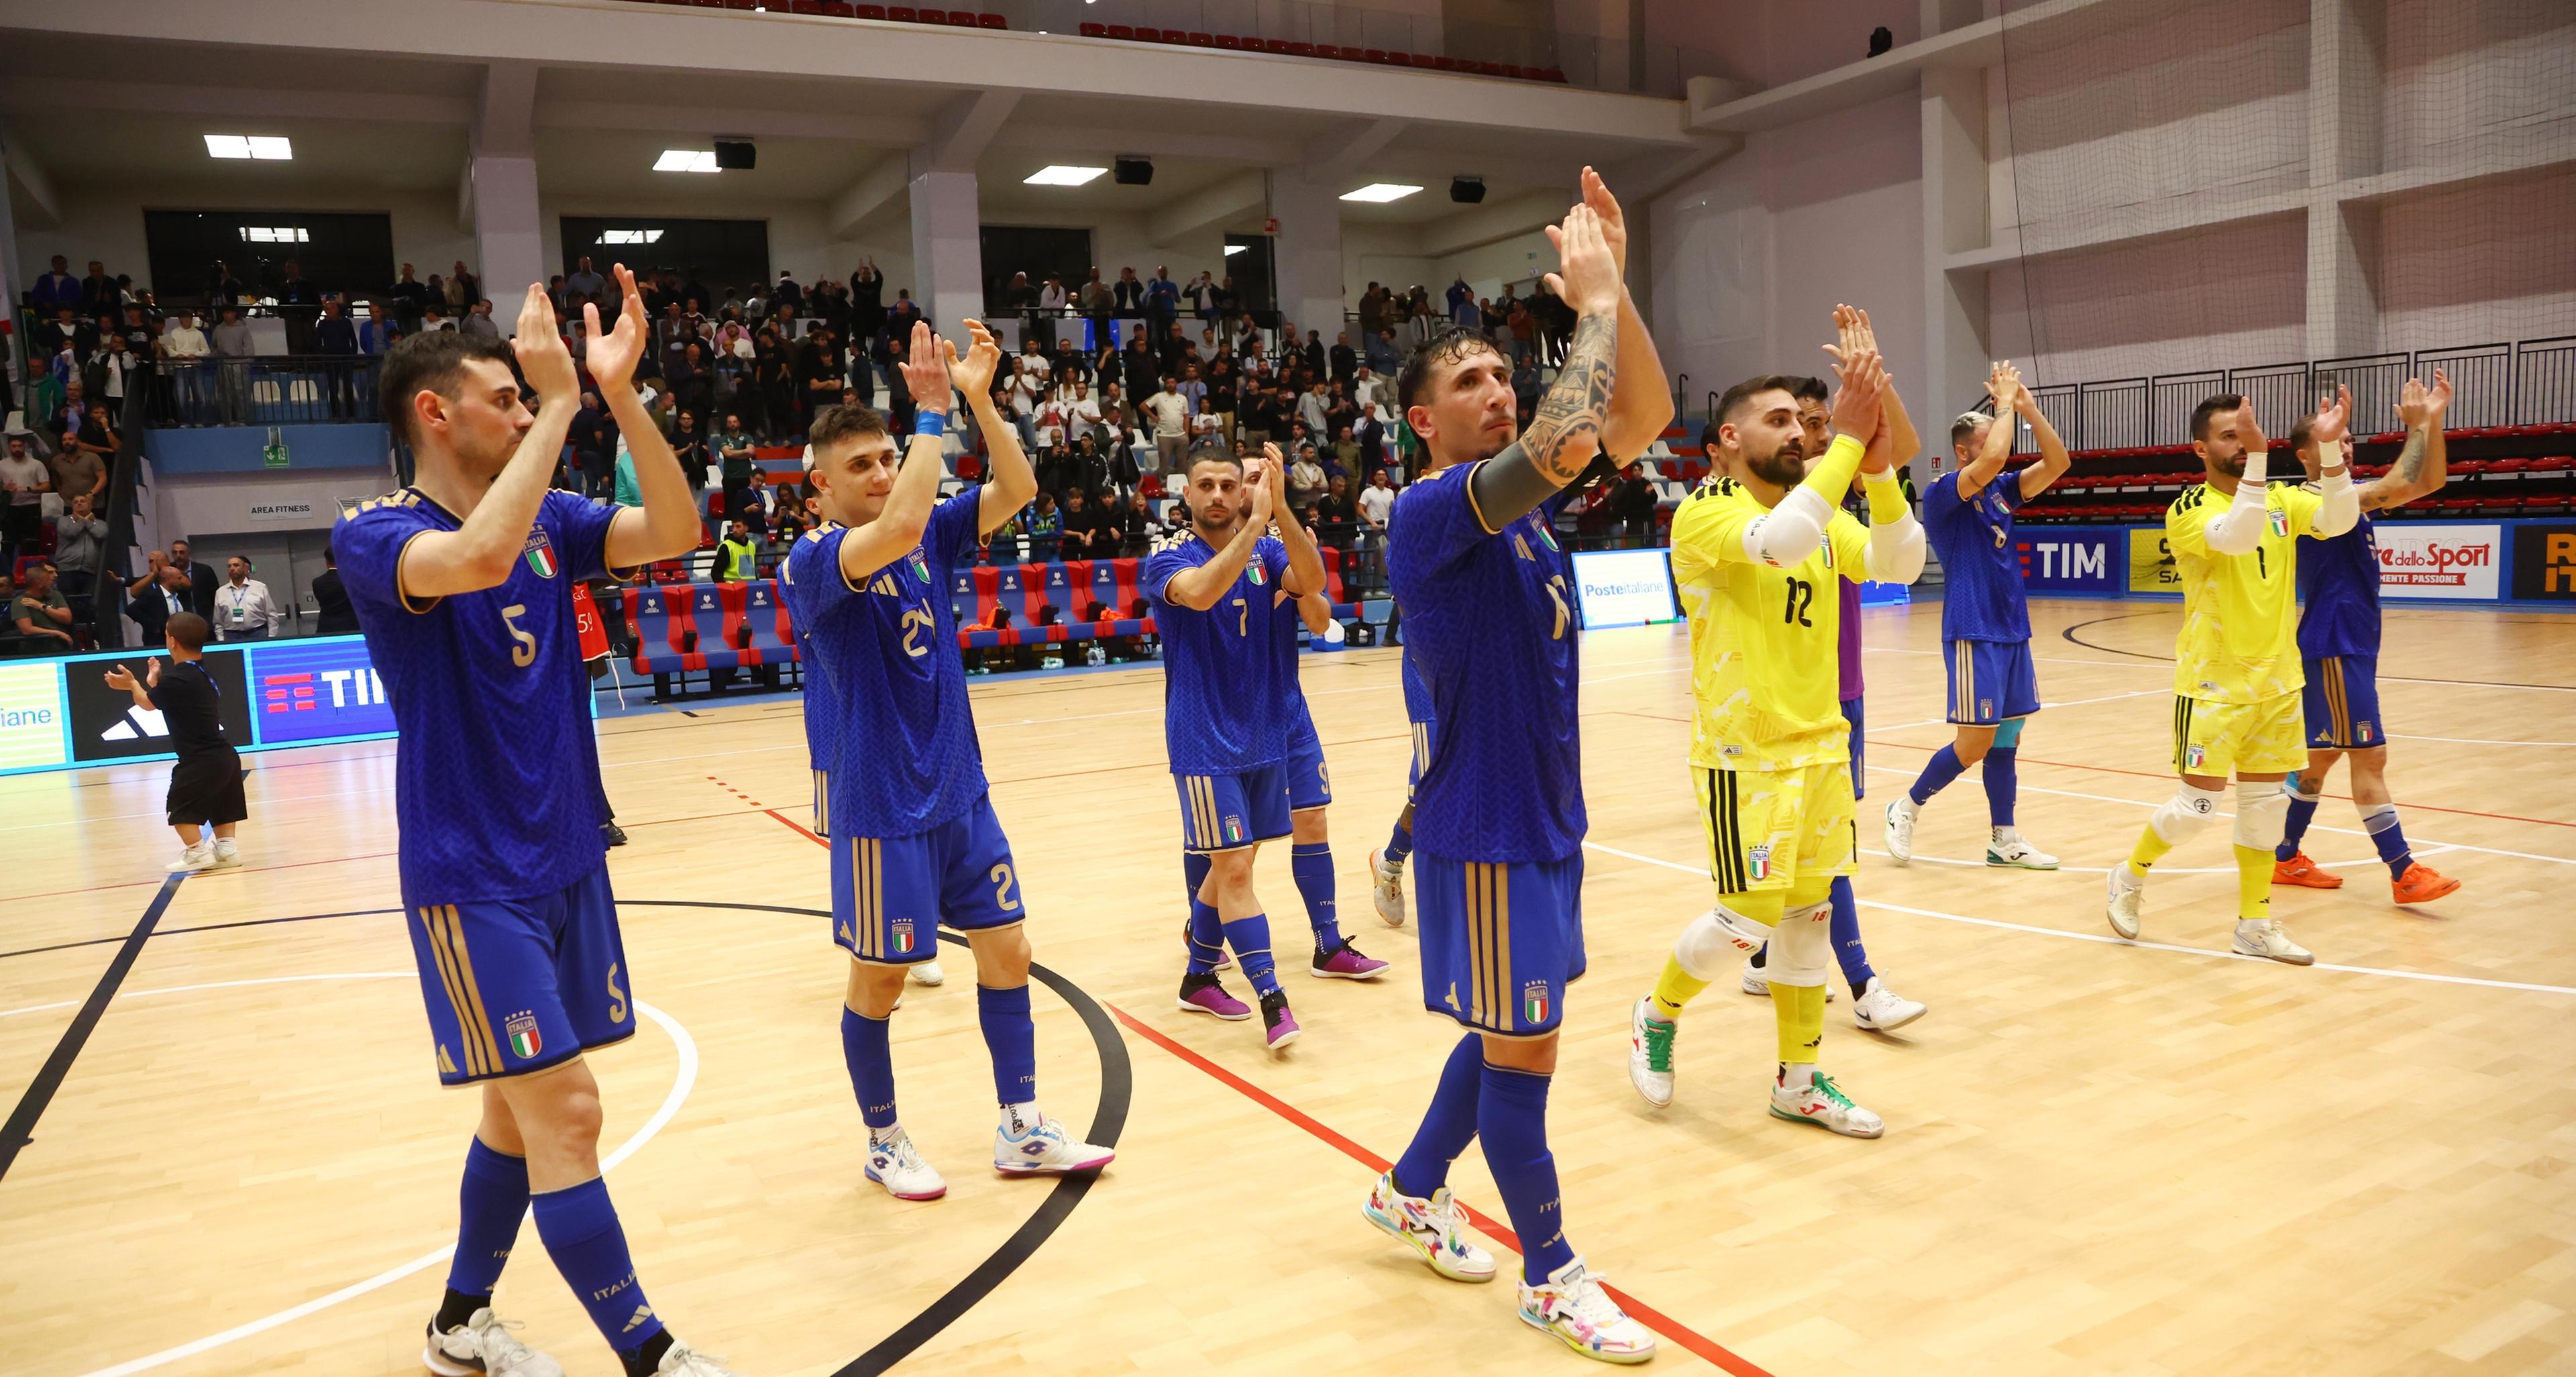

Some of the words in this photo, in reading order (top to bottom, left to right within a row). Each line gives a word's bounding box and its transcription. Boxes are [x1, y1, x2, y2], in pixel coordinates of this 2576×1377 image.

[2037, 543, 2105, 579] TIM
[2256, 546, 2266, 580] 1
[2395, 551, 2425, 566] dello
[2426, 543, 2490, 573] Sport
[1585, 581, 1664, 596] Posteitaliane
[2412, 575, 2458, 584] PASSIONE
[1232, 598, 1248, 637] 7
[1785, 576, 1813, 628] 12
[502, 604, 536, 667] 5
[894, 924, 912, 932] ITALIA
[608, 962, 627, 1024] 5
[1527, 988, 1546, 998] ITALIA
[510, 1020, 534, 1034] ITALIA
